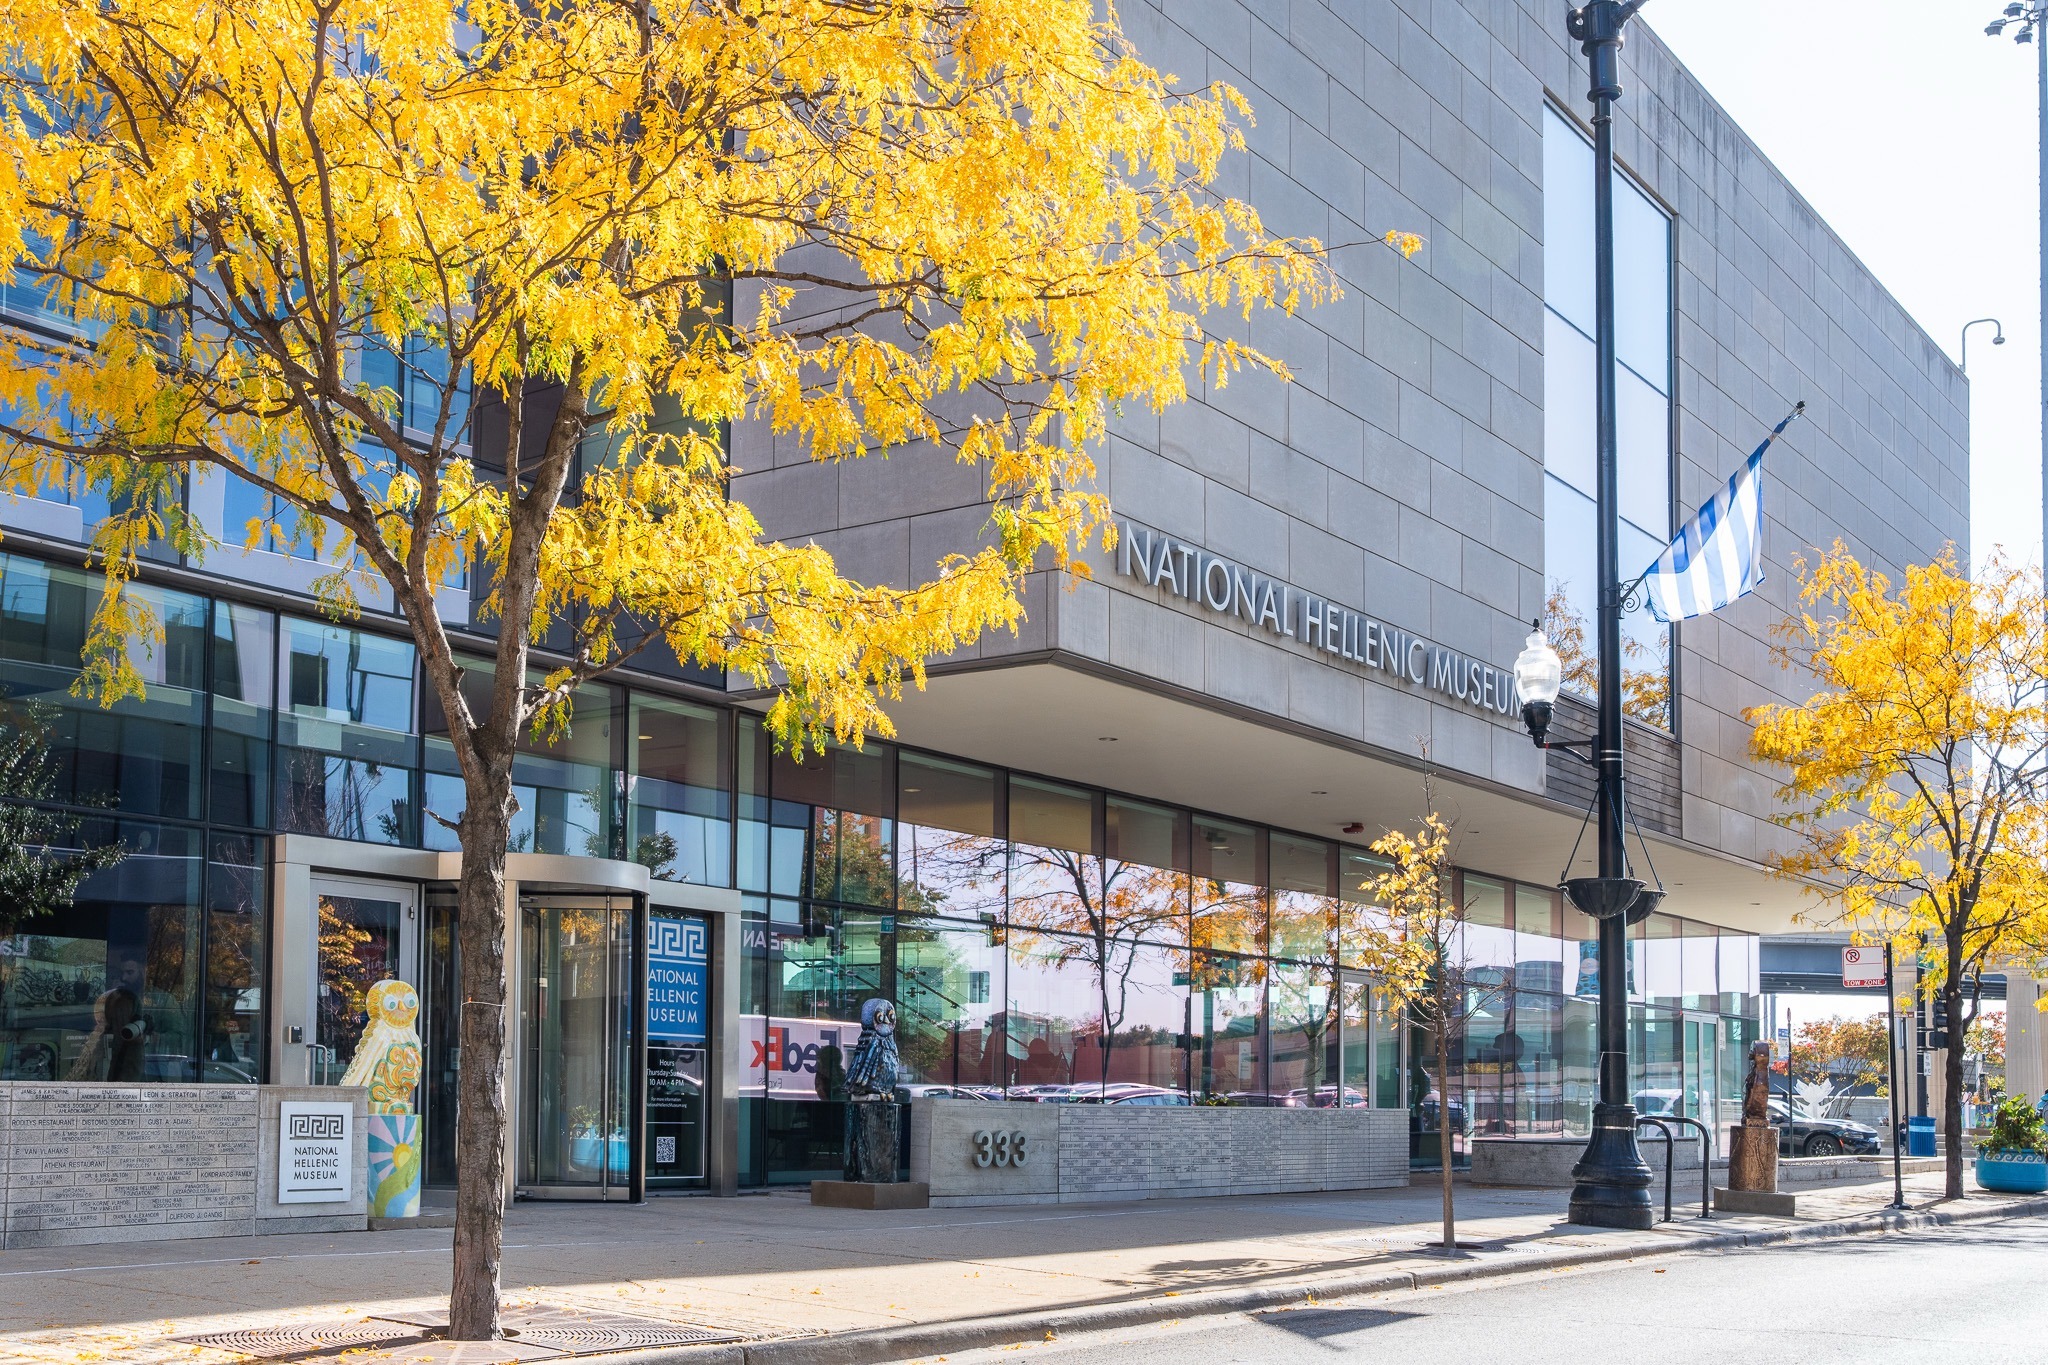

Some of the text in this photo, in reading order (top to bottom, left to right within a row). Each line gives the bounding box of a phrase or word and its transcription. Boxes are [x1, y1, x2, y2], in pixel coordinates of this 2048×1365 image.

[1119, 520, 1294, 637] NATIONAL
[1302, 595, 1425, 684] HELLENIC
[648, 968, 699, 985] ATIONAL
[648, 988, 698, 1004] ELLENIC
[651, 1007, 698, 1023] USEUM
[659, 1058, 675, 1066] Hours
[294, 1146, 338, 1156] NATIONAL
[974, 1130, 1029, 1167] 333
[294, 1158, 338, 1168] HELLENIC
[294, 1170, 337, 1180] MUSEUM
